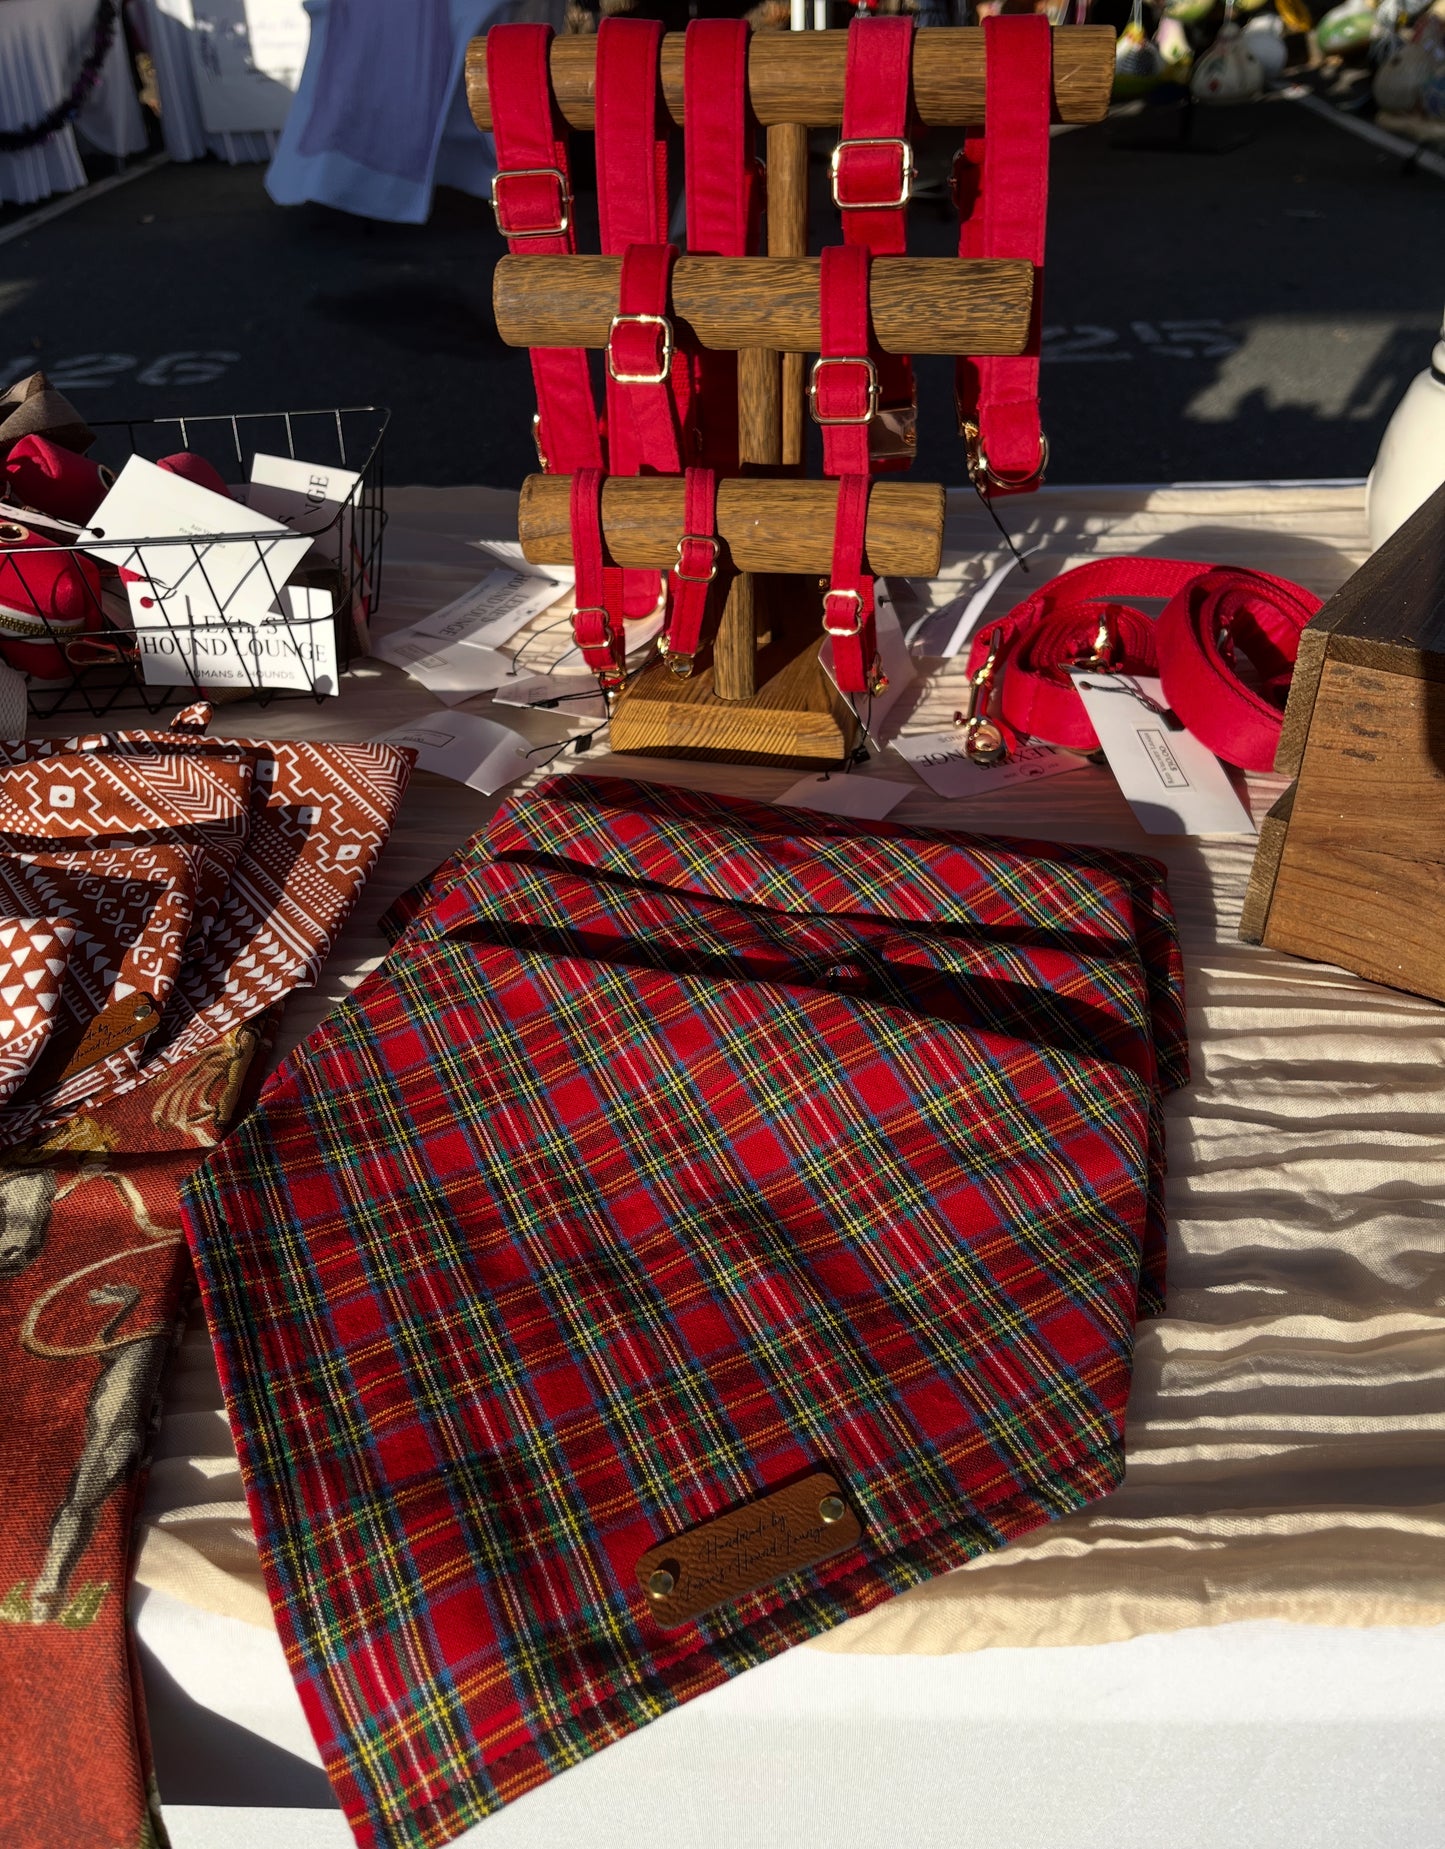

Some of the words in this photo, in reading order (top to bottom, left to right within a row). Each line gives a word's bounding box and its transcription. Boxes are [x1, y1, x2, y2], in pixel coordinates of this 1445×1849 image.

[141, 636, 228, 657] HOUND
[234, 638, 328, 663] LOUNGE
[772, 1512, 785, 1531] by
